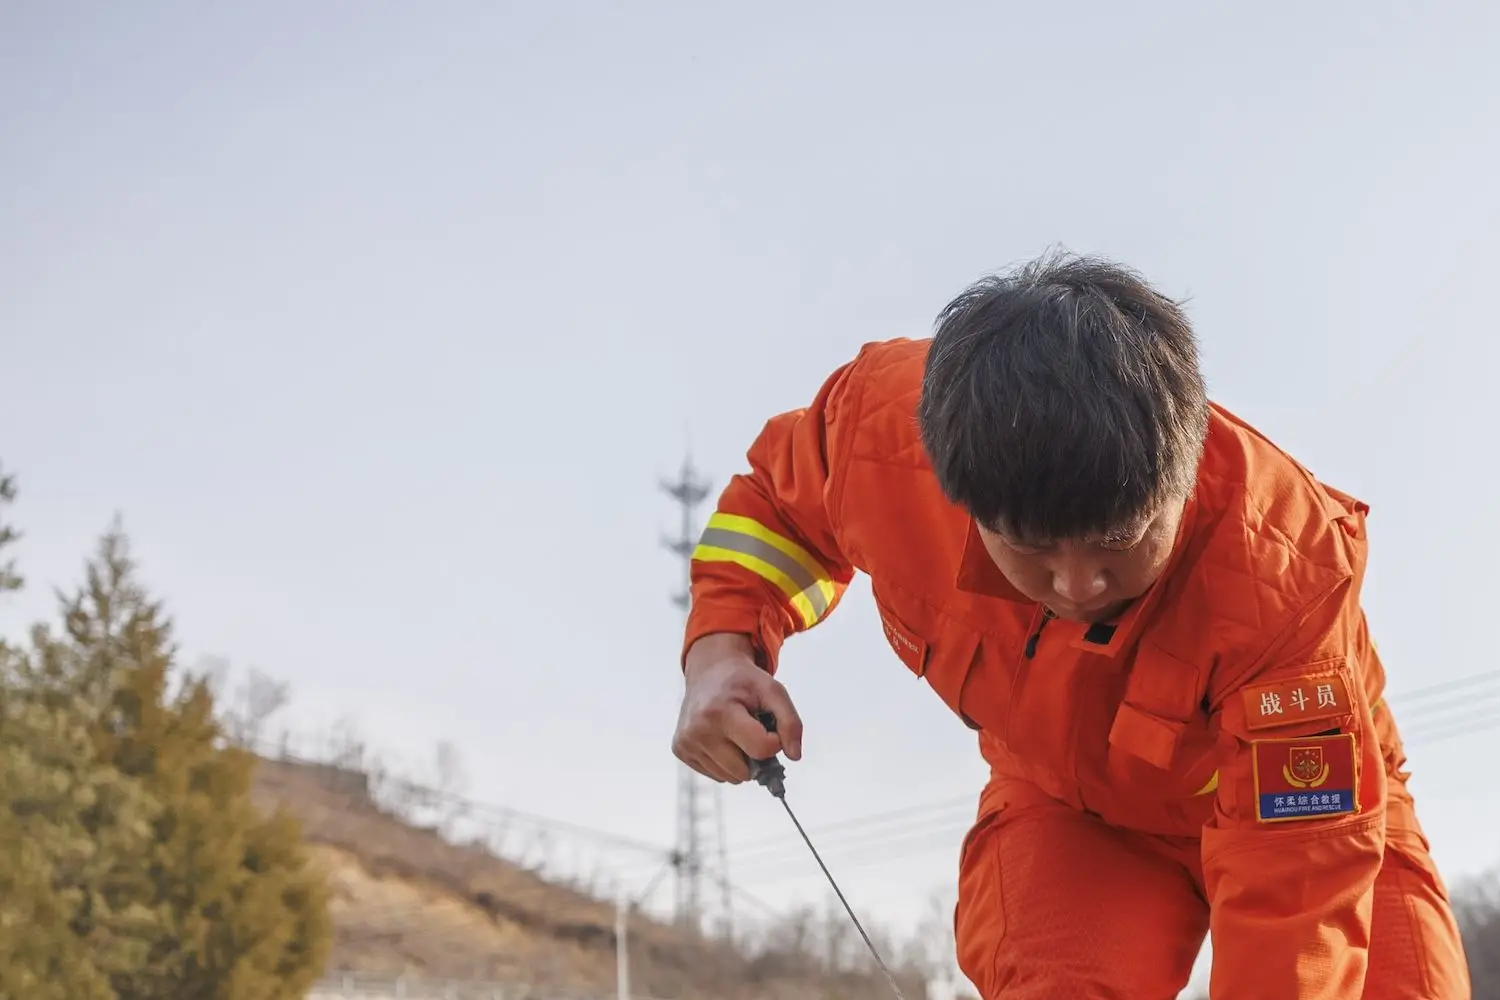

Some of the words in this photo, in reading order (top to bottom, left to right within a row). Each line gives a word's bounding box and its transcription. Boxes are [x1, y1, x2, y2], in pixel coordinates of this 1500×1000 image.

[1260, 684, 1337, 716] 战斗员
[1274, 793, 1341, 807] 怀柔综合救援
